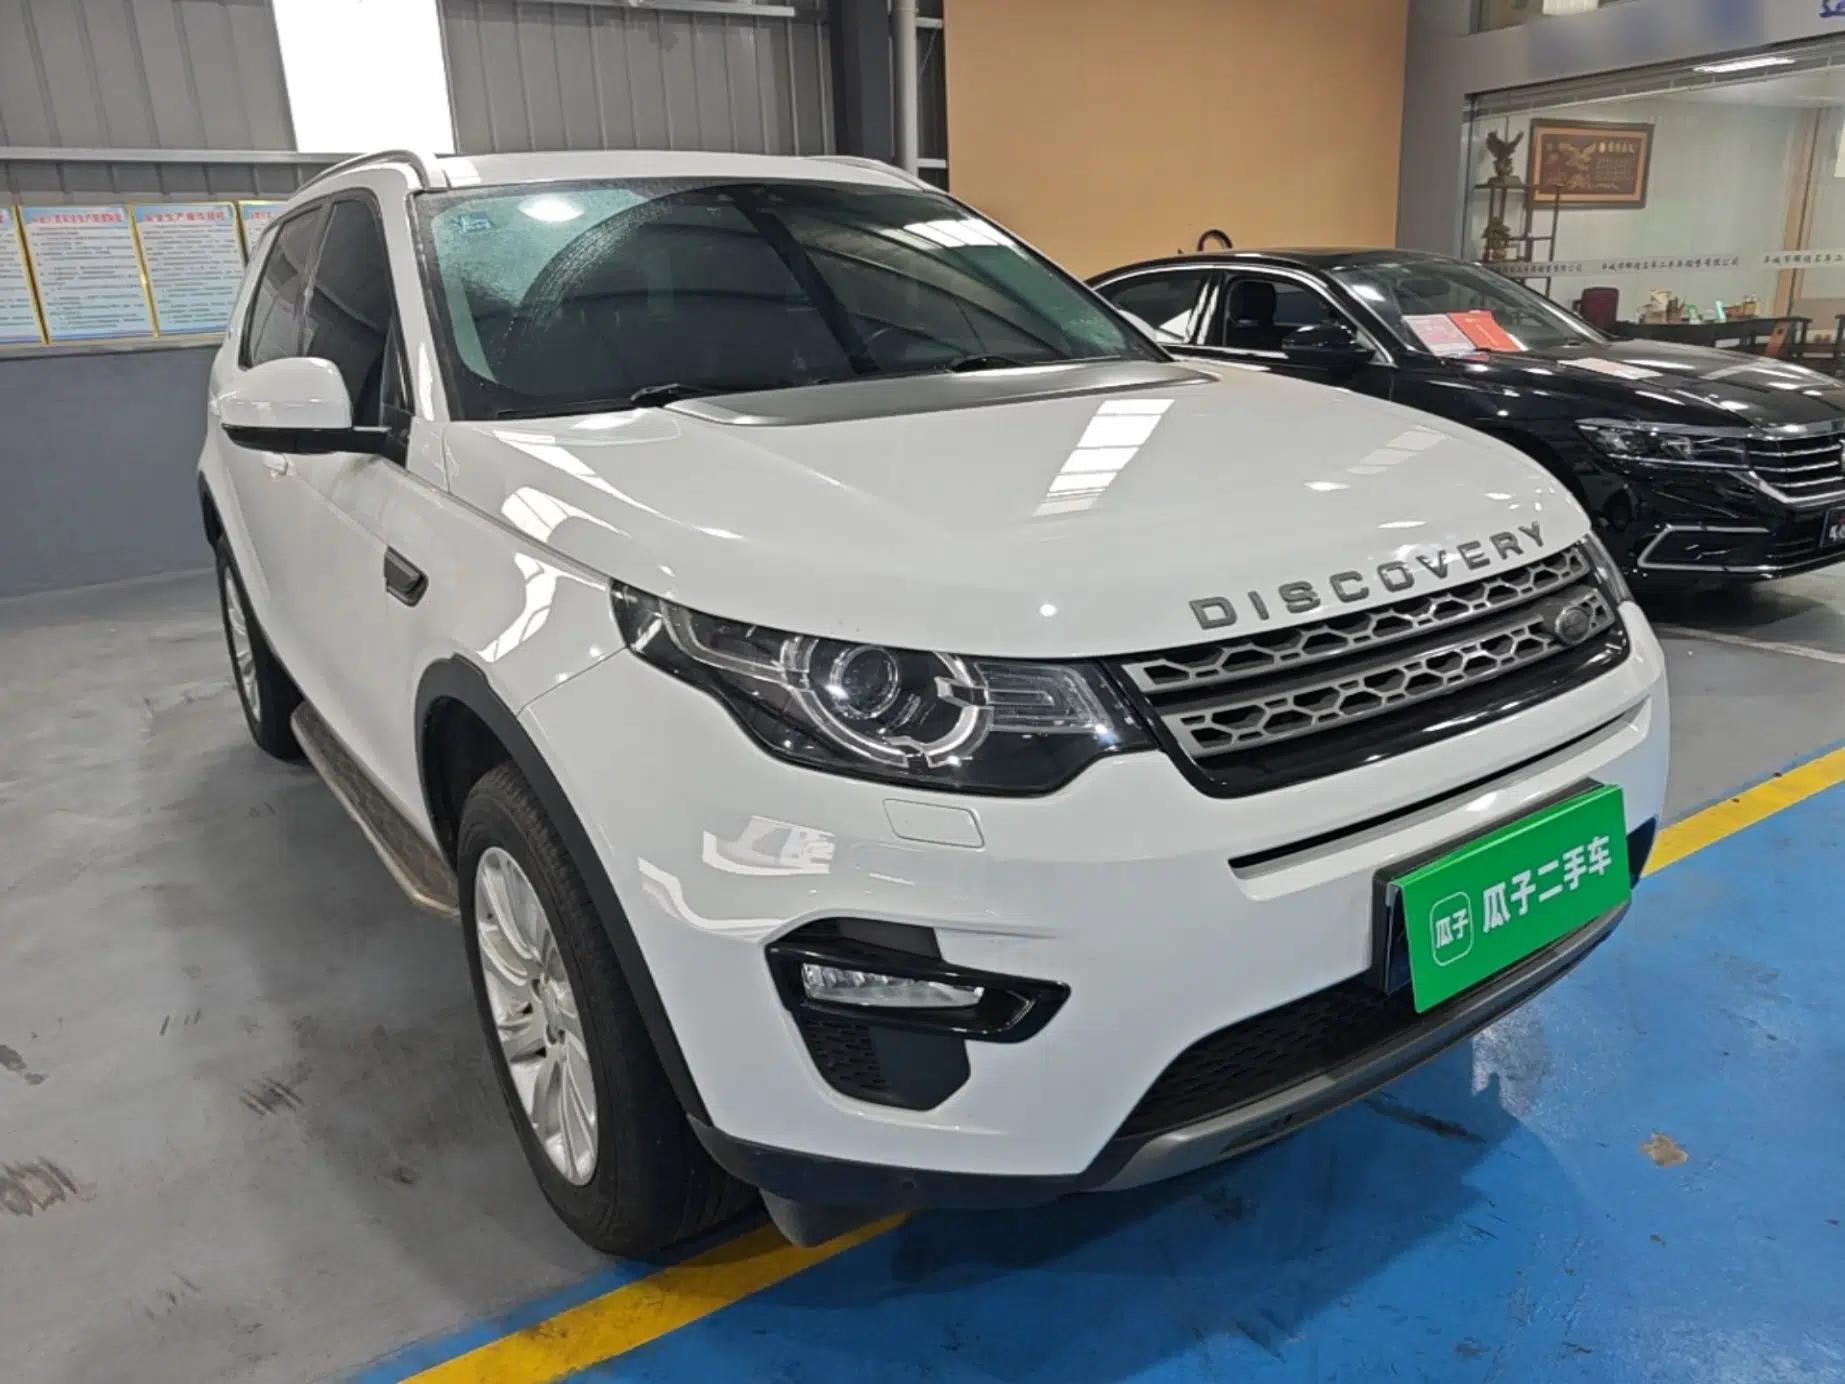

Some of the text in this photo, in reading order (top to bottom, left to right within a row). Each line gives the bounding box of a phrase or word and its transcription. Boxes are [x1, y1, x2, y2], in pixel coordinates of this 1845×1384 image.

[1188, 520, 1546, 630] DISCOVERY
[1434, 907, 1469, 949] 瓜子
[1482, 835, 1612, 933] 瓜子二手车
